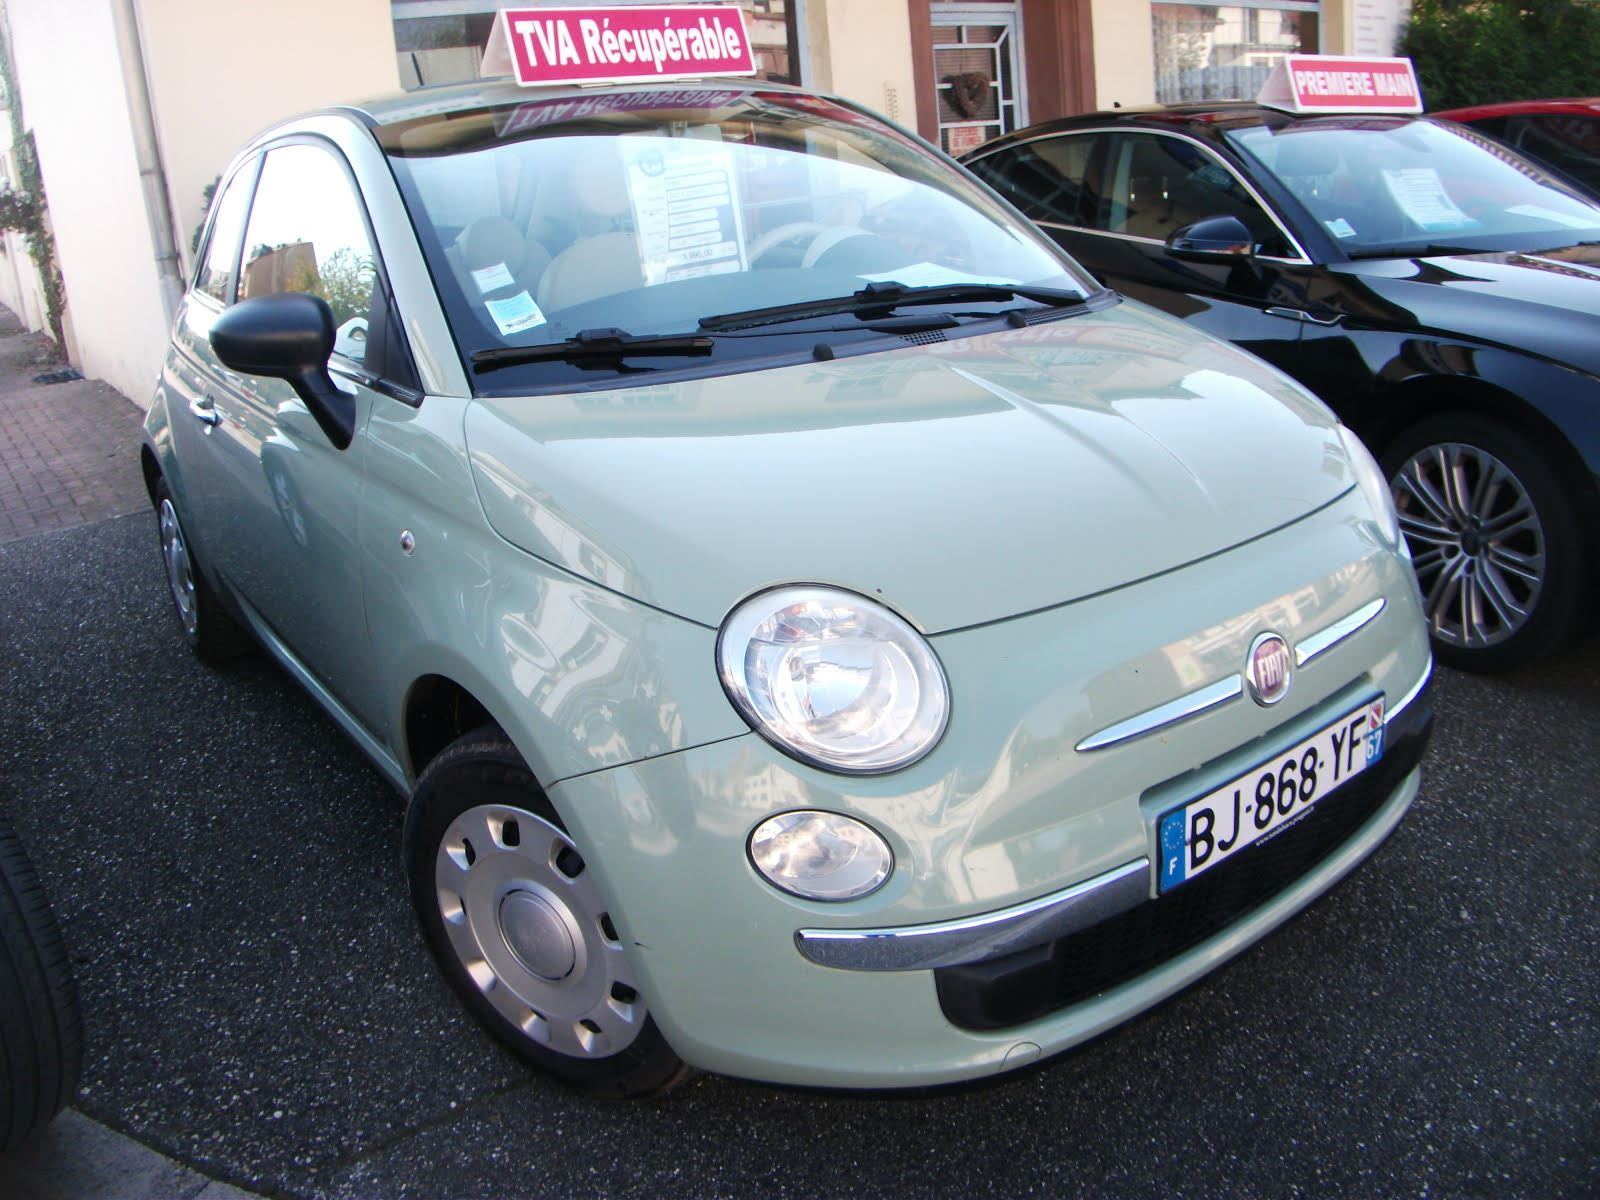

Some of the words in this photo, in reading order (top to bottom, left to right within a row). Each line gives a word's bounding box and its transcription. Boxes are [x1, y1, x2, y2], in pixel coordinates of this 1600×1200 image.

[515, 20, 581, 67] TVA
[580, 17, 742, 72] Récupérable
[1295, 70, 1375, 96] PREMIERE
[1373, 72, 1414, 97] MAIN
[1257, 648, 1287, 690] FIAT
[1367, 730, 1382, 760] 67
[1169, 857, 1178, 875] F
